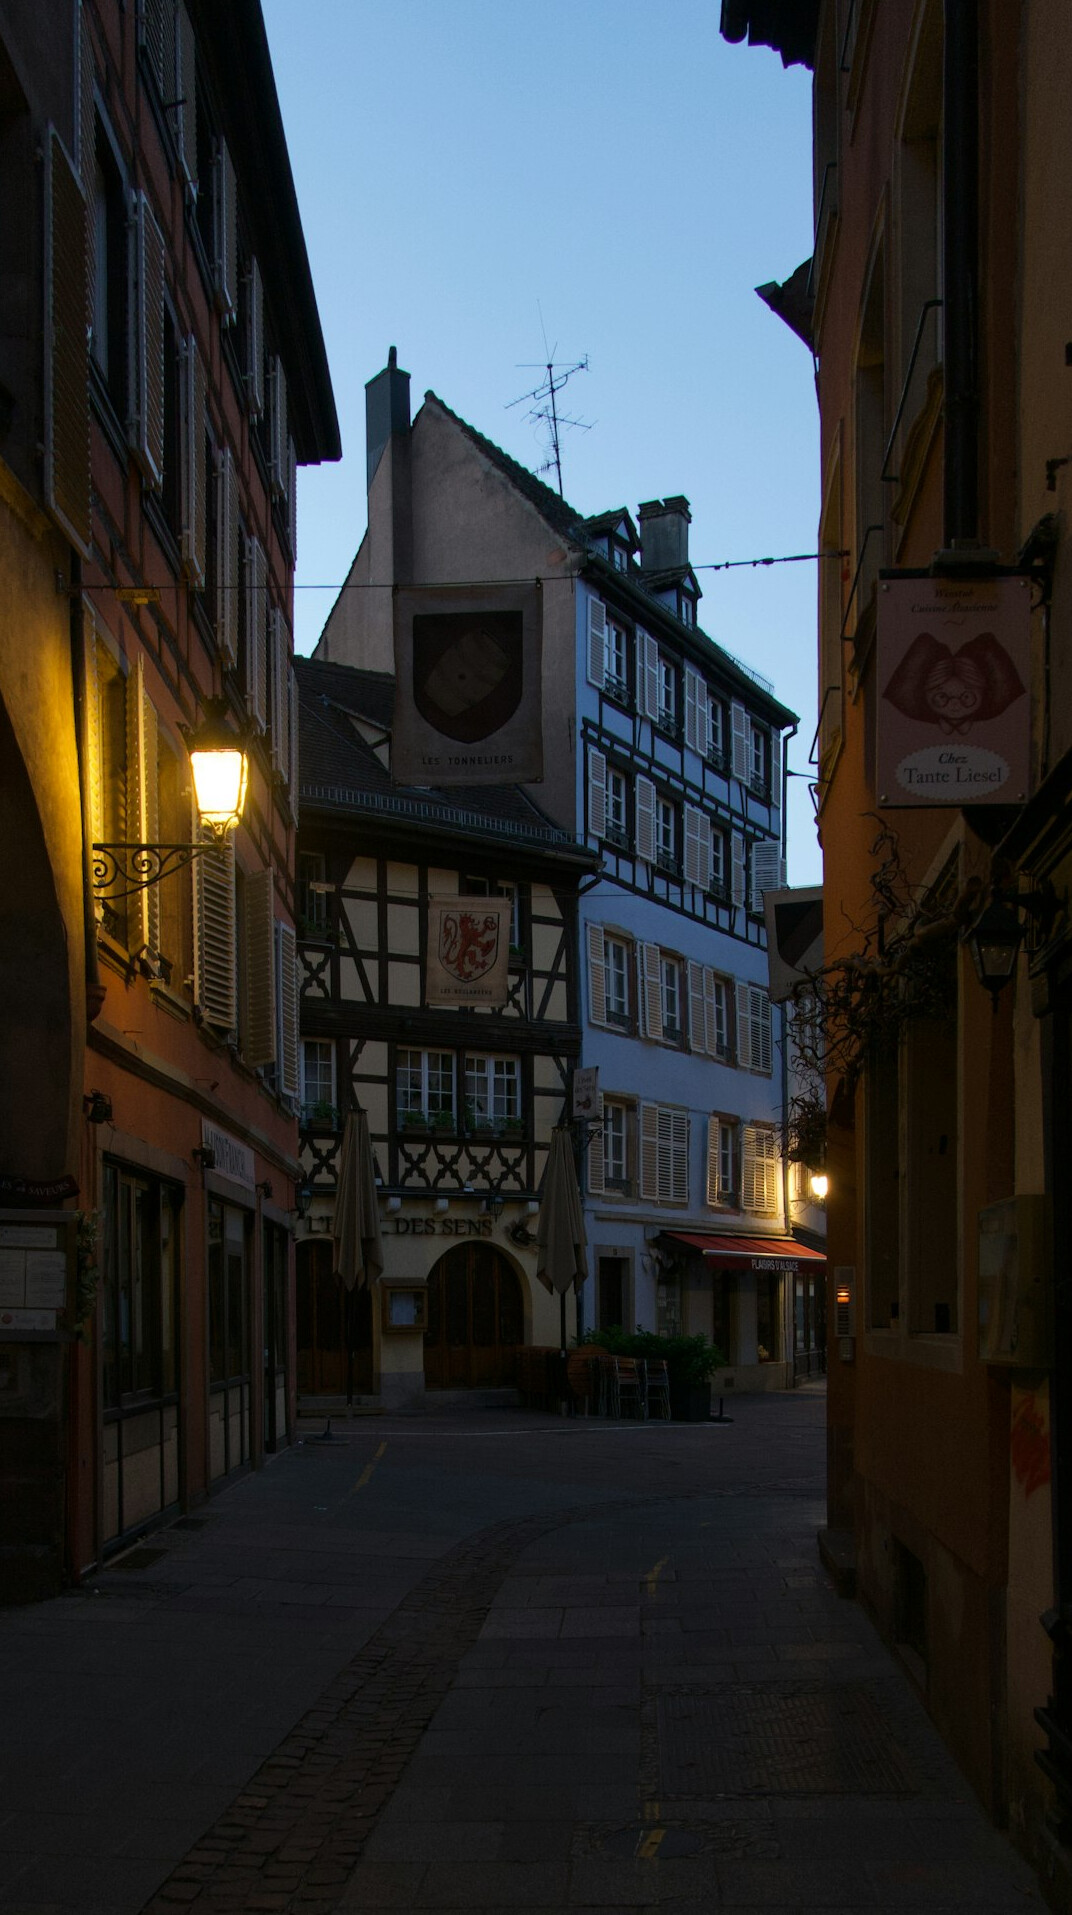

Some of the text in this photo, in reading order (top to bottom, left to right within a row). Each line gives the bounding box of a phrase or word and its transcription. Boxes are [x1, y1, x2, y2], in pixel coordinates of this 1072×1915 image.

[422, 755, 513, 765] LES TONNELIERS
[938, 752, 968, 764] Chez
[903, 767, 1001, 784] Tante Liesel
[28, 1182, 71, 1197] SAVEURS
[394, 1217, 435, 1235] DES
[442, 1218, 492, 1236] SENS
[751, 1258, 799, 1272] PLAISIRS D'ALSACE
